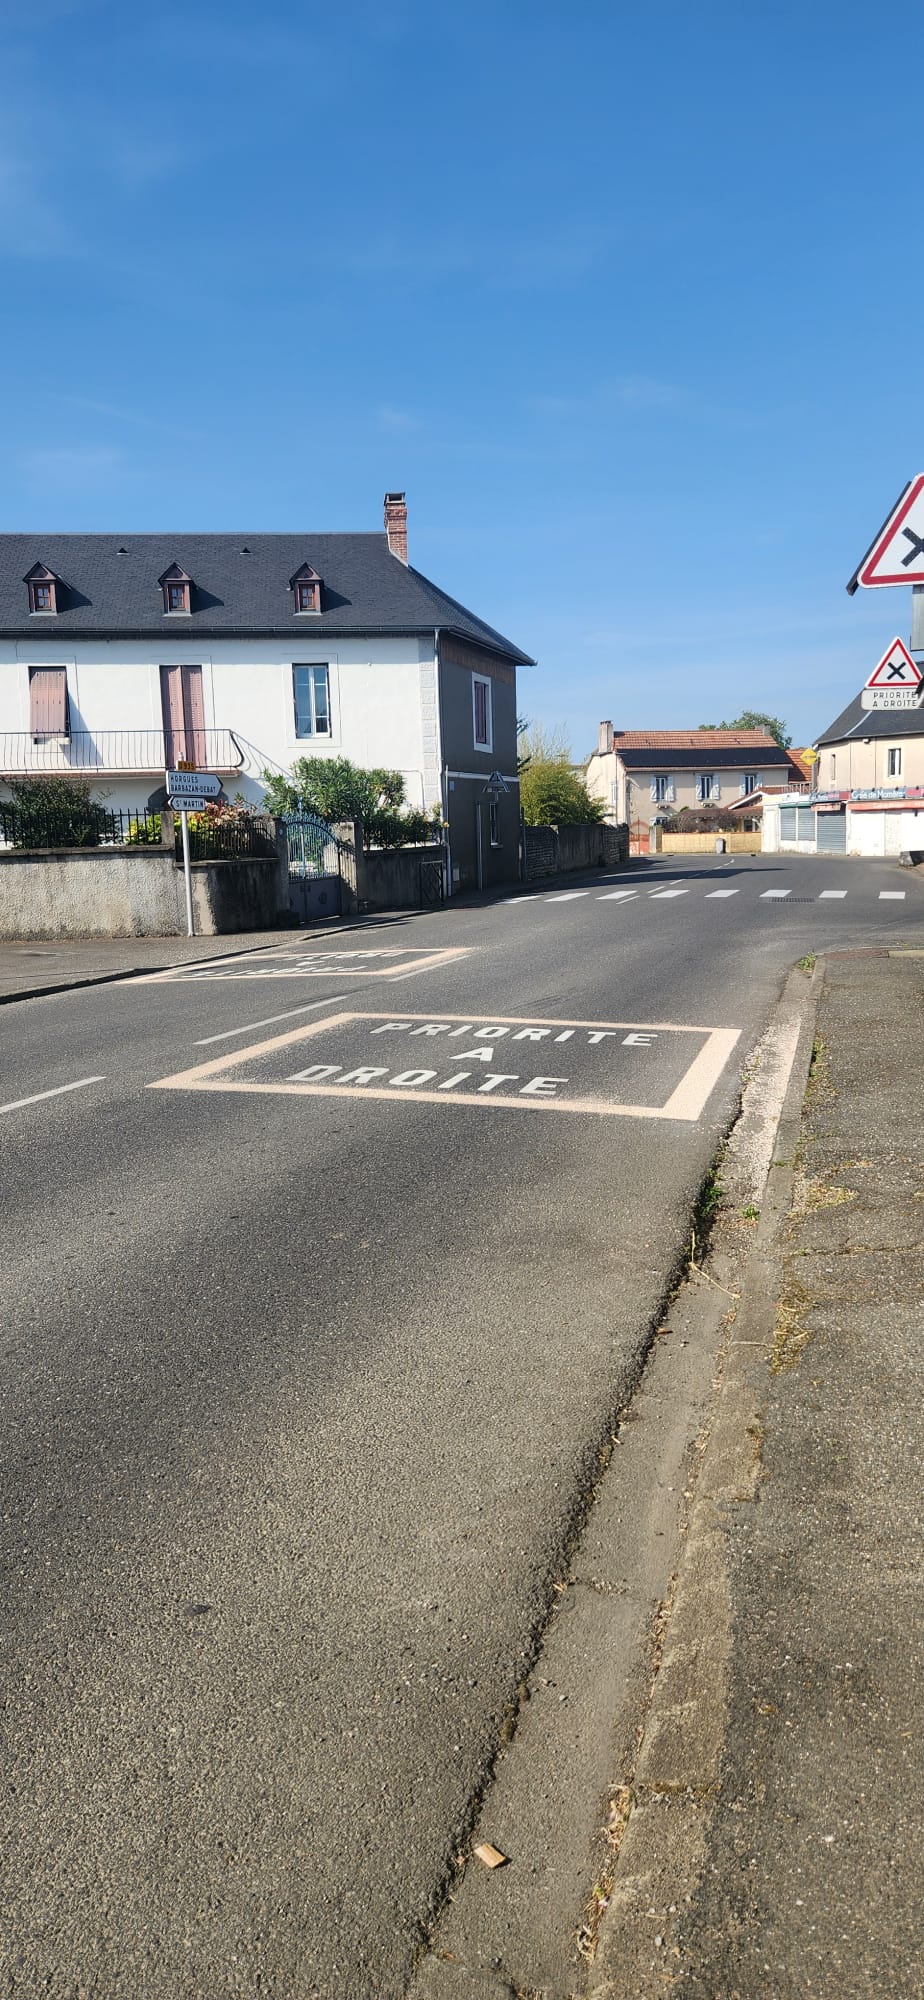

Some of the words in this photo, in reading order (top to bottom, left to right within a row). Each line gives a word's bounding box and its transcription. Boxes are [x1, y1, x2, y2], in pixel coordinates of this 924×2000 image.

[171, 775, 199, 783] HORGUES
[183, 800, 204, 808] MARTIN
[369, 1022, 659, 1047] PRIORITE
[448, 1046, 495, 1062] A
[285, 1064, 569, 1096] DROITE
